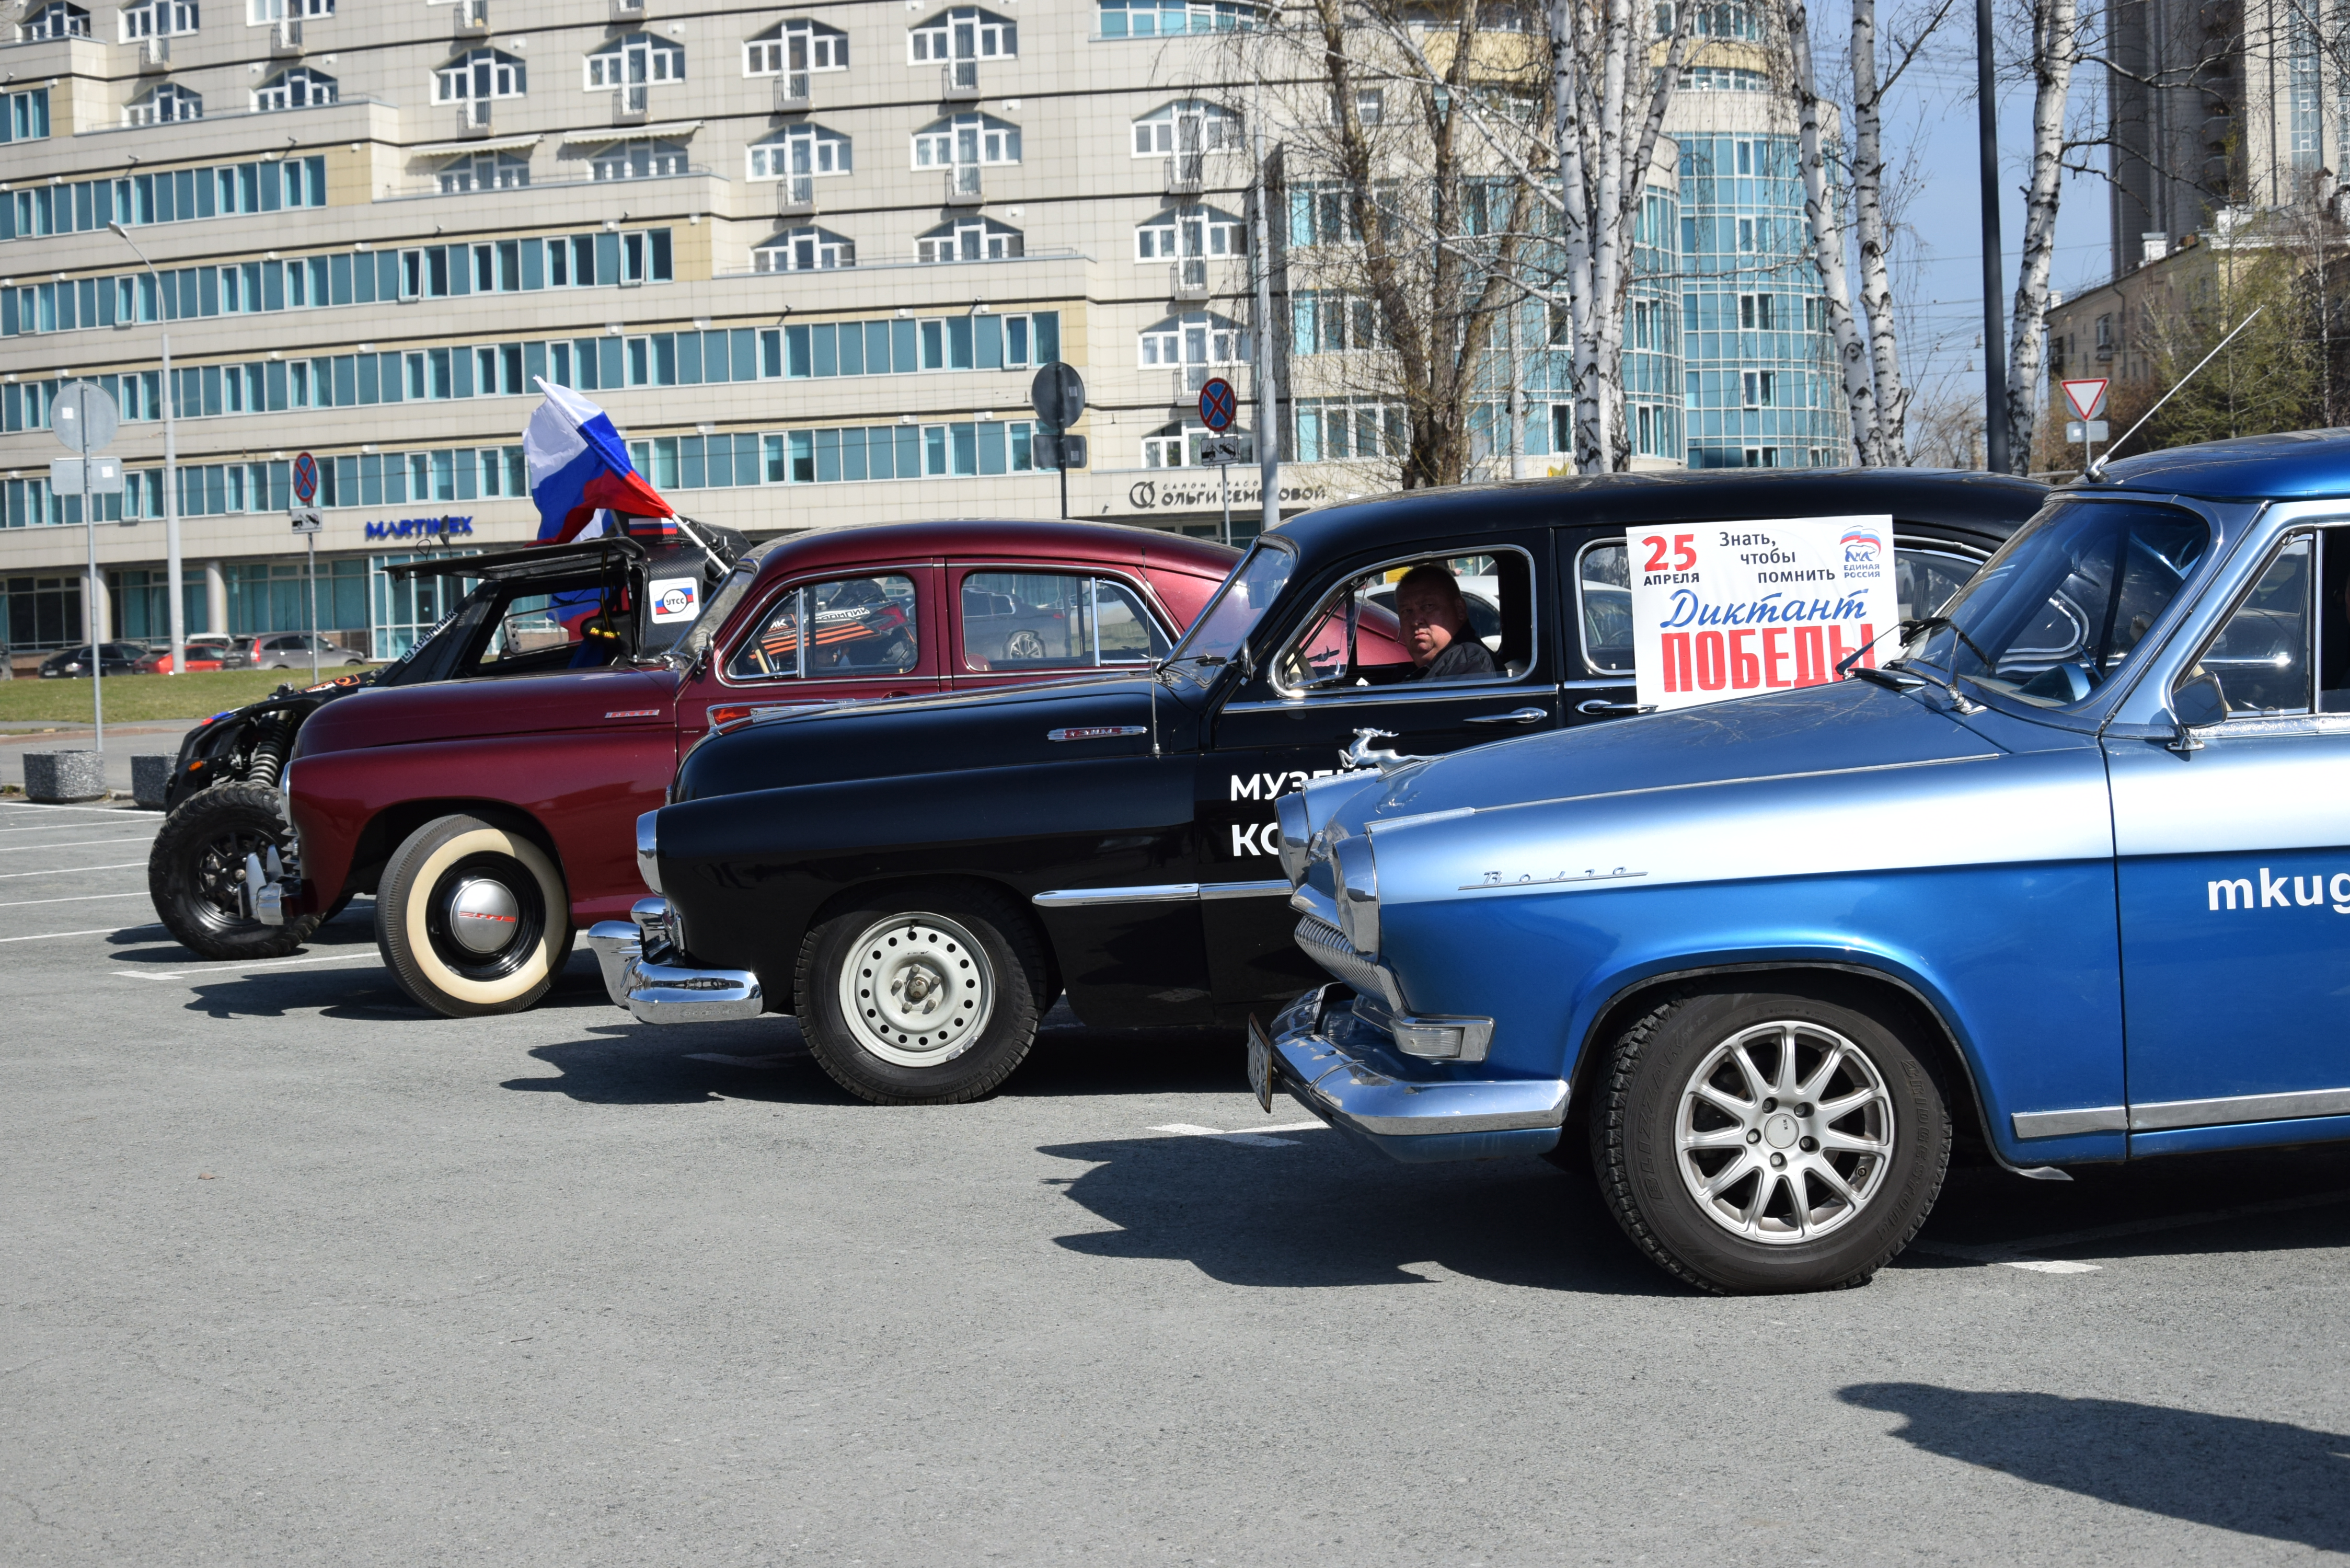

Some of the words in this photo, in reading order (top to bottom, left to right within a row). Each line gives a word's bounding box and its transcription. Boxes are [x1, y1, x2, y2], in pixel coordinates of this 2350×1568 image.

[1161, 491, 1217, 506] ОЛЬГИ
[1222, 485, 1325, 504] СЕМЕОВОЙ
[1642, 534, 1697, 572] 25
[1720, 532, 1776, 547] Знать,
[1741, 548, 1796, 565] чтобы
[1643, 572, 1700, 586] АПРЕЛЯ
[1758, 569, 1836, 584] помнить
[1660, 589, 1869, 628] Диктант
[411, 610, 457, 652] ХРОМПИК
[1661, 624, 1875, 693] ПОБЕДЫ
[1231, 767, 1374, 801] МУЗ
[2208, 868, 2350, 914] mkug
[939, 1070, 983, 1092] Matador
[1638, 1037, 1684, 1201] BLIZZAK
